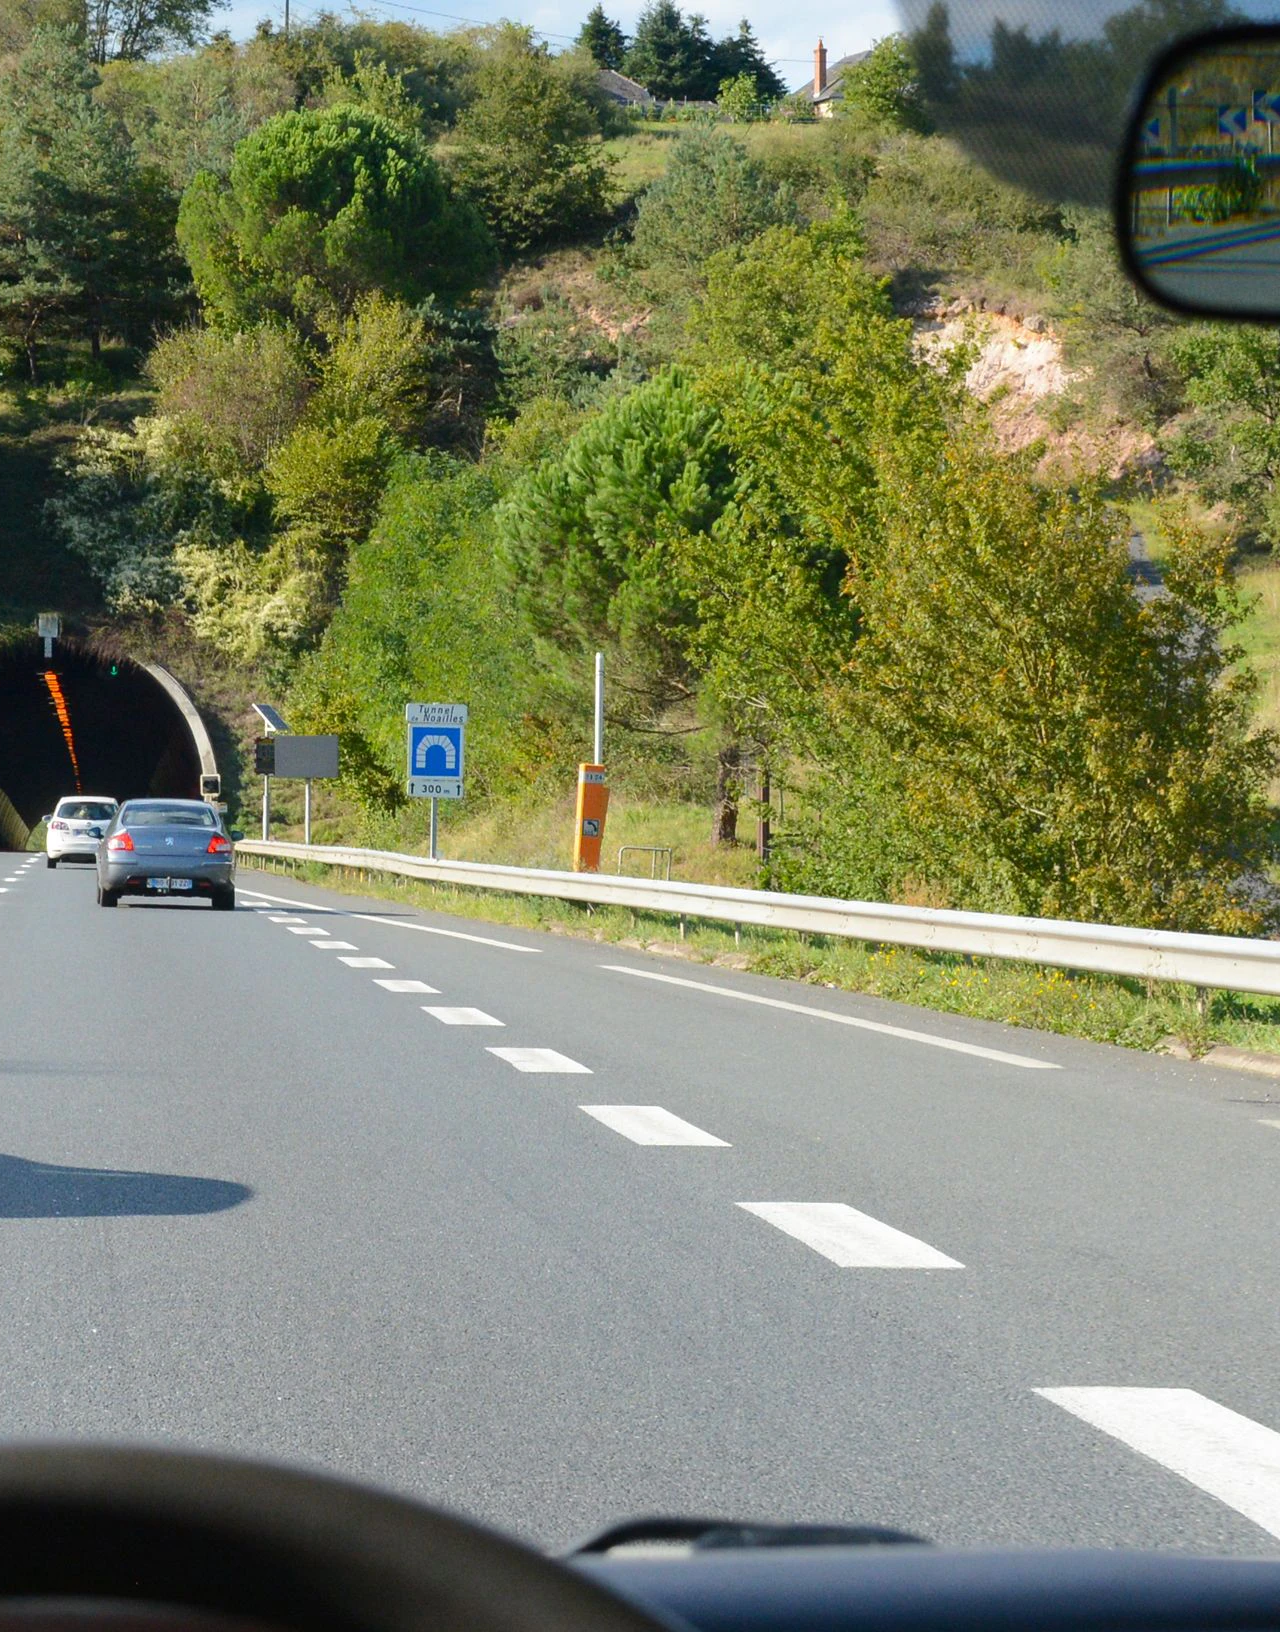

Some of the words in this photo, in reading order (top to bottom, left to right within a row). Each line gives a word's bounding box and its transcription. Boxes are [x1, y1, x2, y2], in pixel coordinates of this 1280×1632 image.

[419, 704, 455, 714] Tunnel
[423, 713, 464, 722] Noailles
[422, 784, 442, 794] 300
